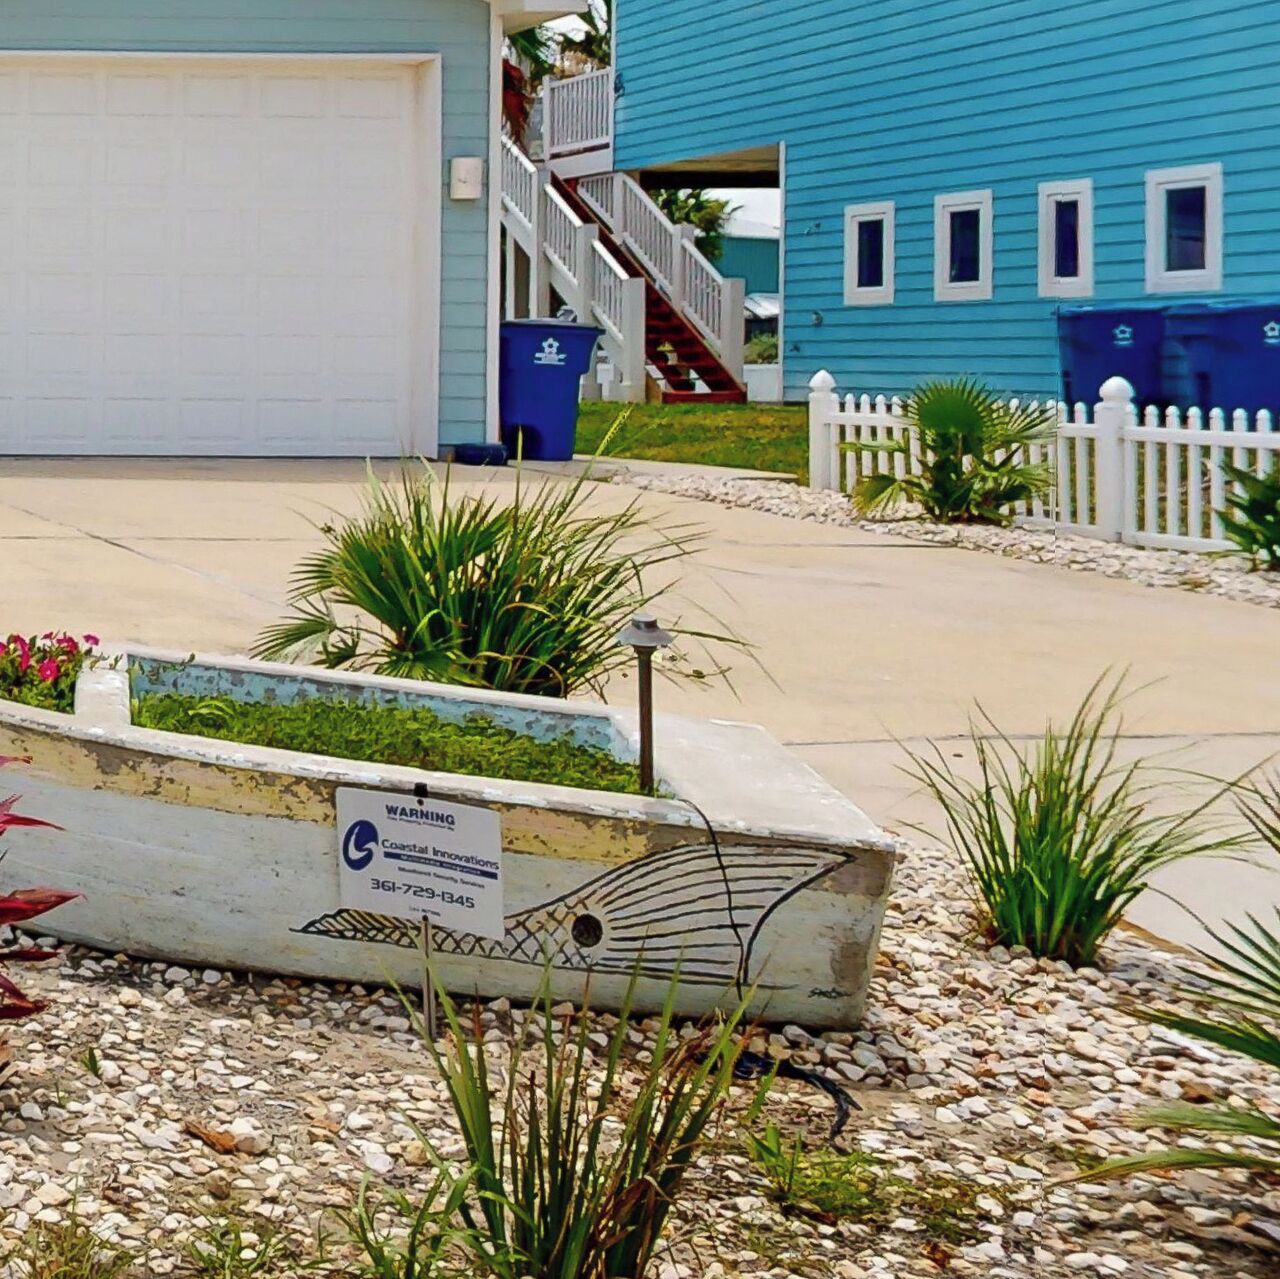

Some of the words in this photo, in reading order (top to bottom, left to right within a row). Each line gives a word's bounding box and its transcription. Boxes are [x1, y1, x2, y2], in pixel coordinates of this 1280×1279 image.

[385, 804, 456, 826] WARNING
[381, 838, 428, 855] Coastal
[432, 846, 500, 870] Innovations
[370, 878, 475, 909] 361-729-1345
